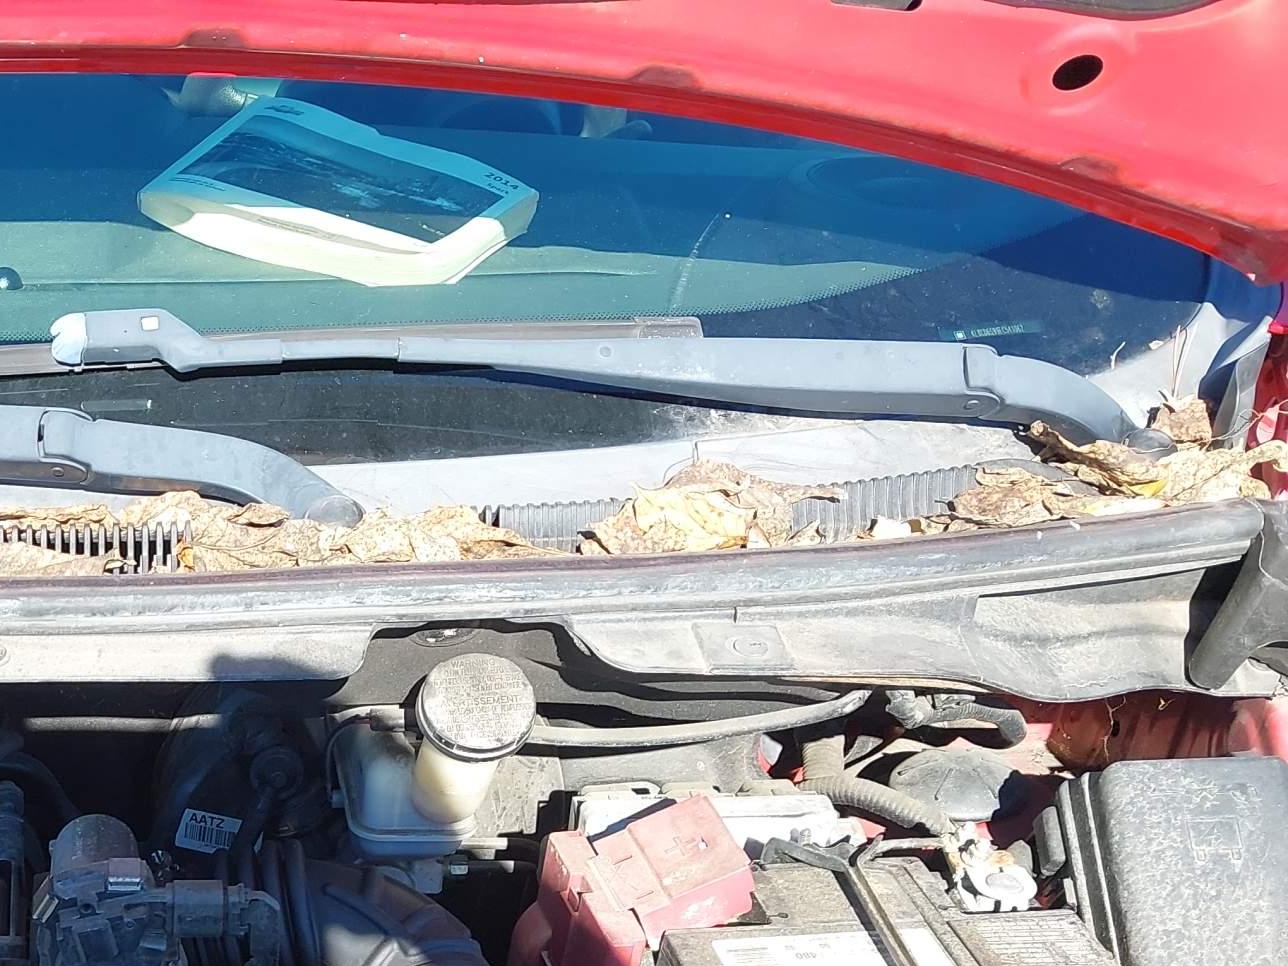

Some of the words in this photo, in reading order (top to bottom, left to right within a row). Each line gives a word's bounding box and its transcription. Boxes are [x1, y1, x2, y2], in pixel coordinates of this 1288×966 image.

[483, 172, 519, 190] 2014
[450, 659, 496, 669] WARNING
[189, 812, 225, 829] AATZ
